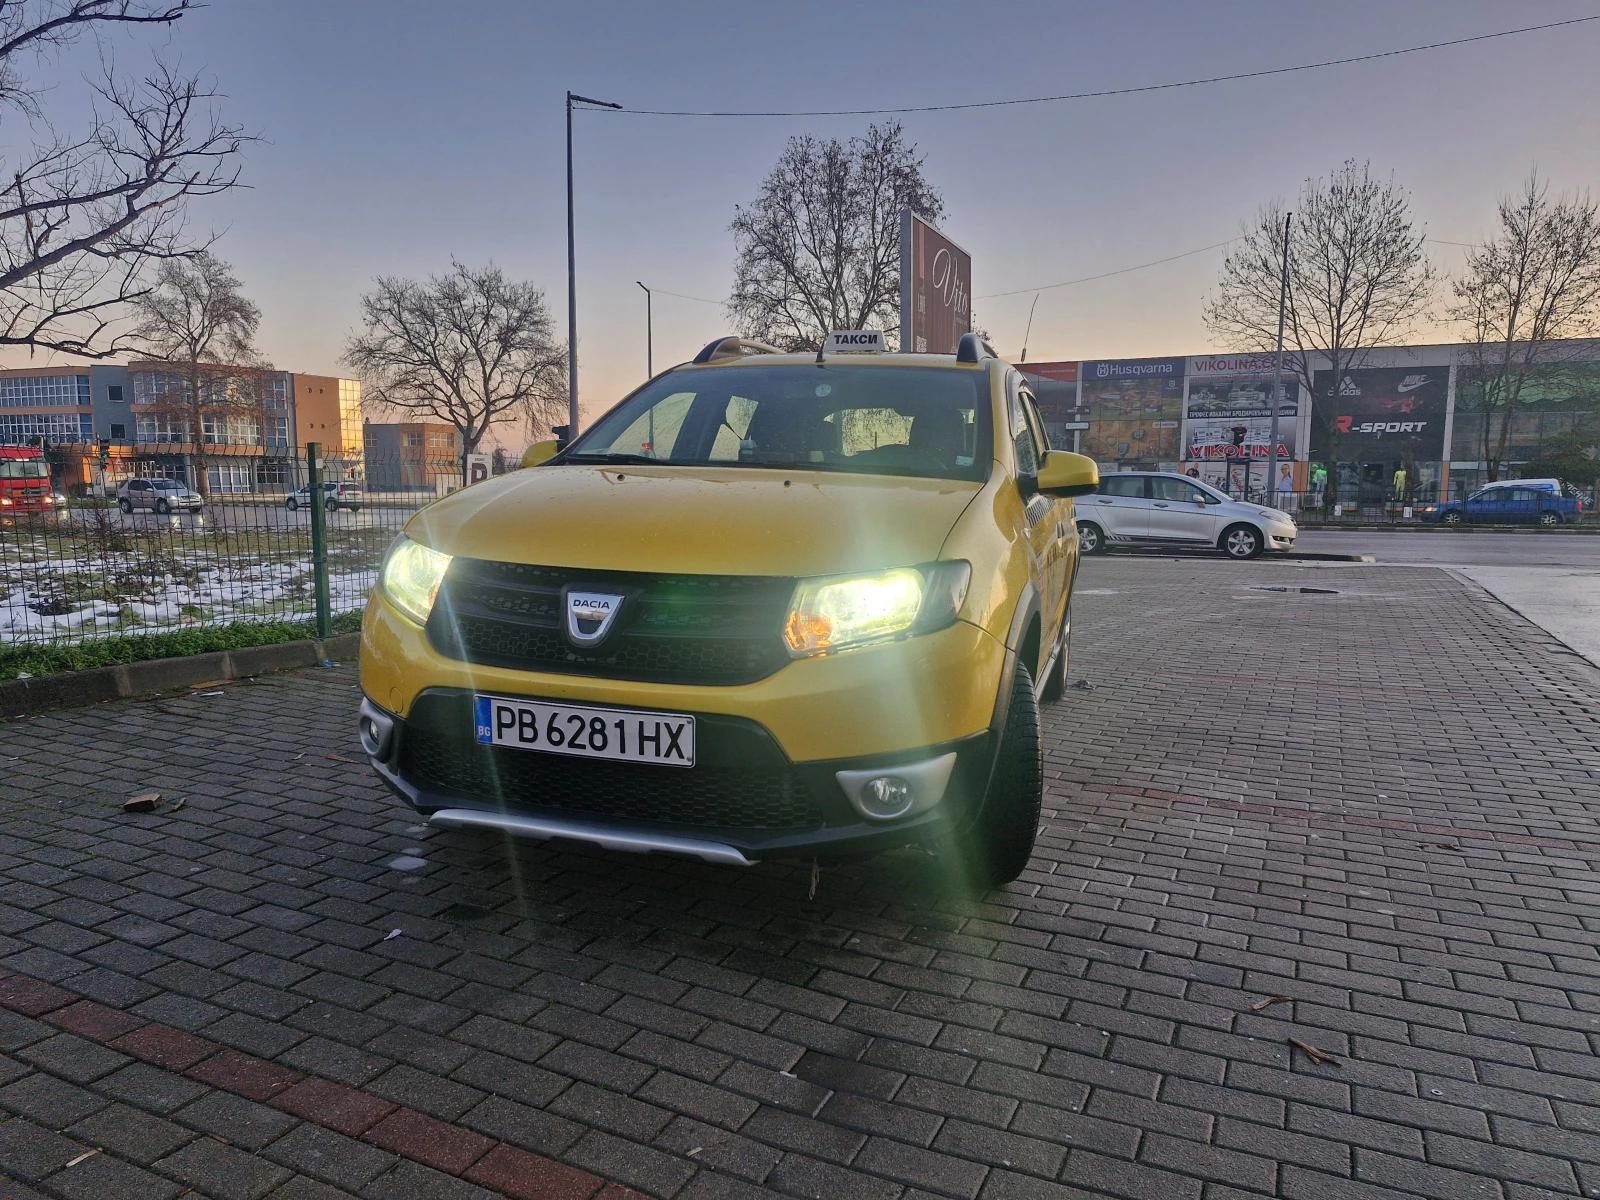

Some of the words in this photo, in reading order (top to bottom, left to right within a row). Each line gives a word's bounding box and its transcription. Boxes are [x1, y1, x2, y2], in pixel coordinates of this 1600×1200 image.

[834, 334, 878, 345] ТАКСИ
[1109, 363, 1173, 375] Husqvarna
[1403, 374, 1427, 385] NIKE
[1331, 415, 1427, 434] R-SPORT
[1189, 444, 1290, 457] VIKOLINA
[573, 599, 610, 610] DACIA
[478, 726, 491, 737] BG
[496, 705, 538, 743] PB
[546, 712, 626, 754] 6281
[638, 720, 685, 760] HX
